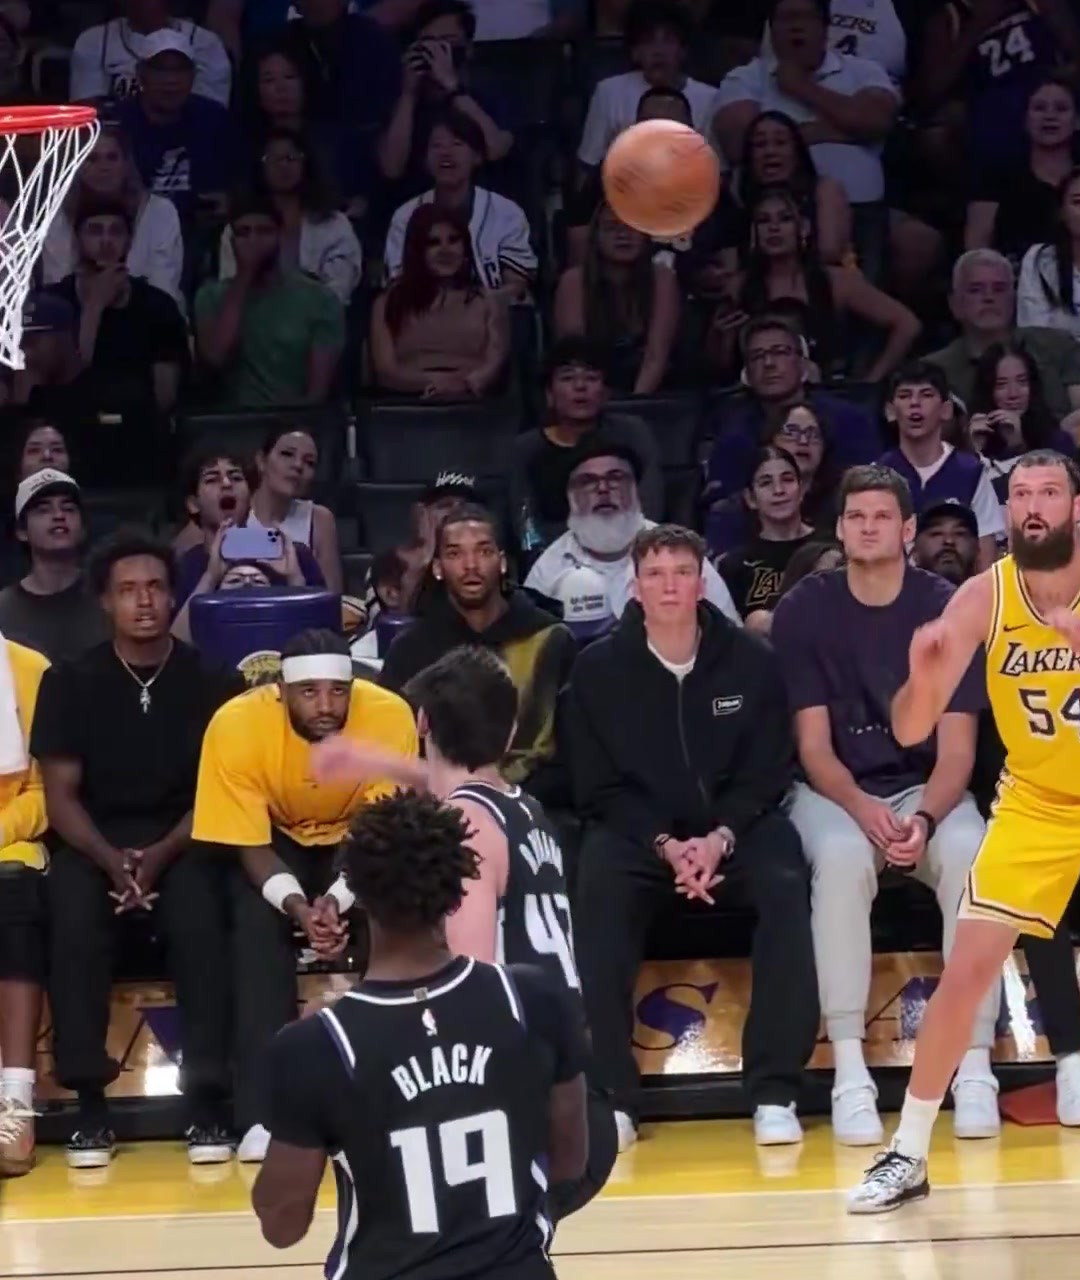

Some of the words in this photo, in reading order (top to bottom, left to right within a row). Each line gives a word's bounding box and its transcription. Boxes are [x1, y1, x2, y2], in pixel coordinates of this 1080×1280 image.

[978, 24, 1036, 78] 24
[391, 1042, 493, 1102] BLACK
[389, 1109, 518, 1234] 19
